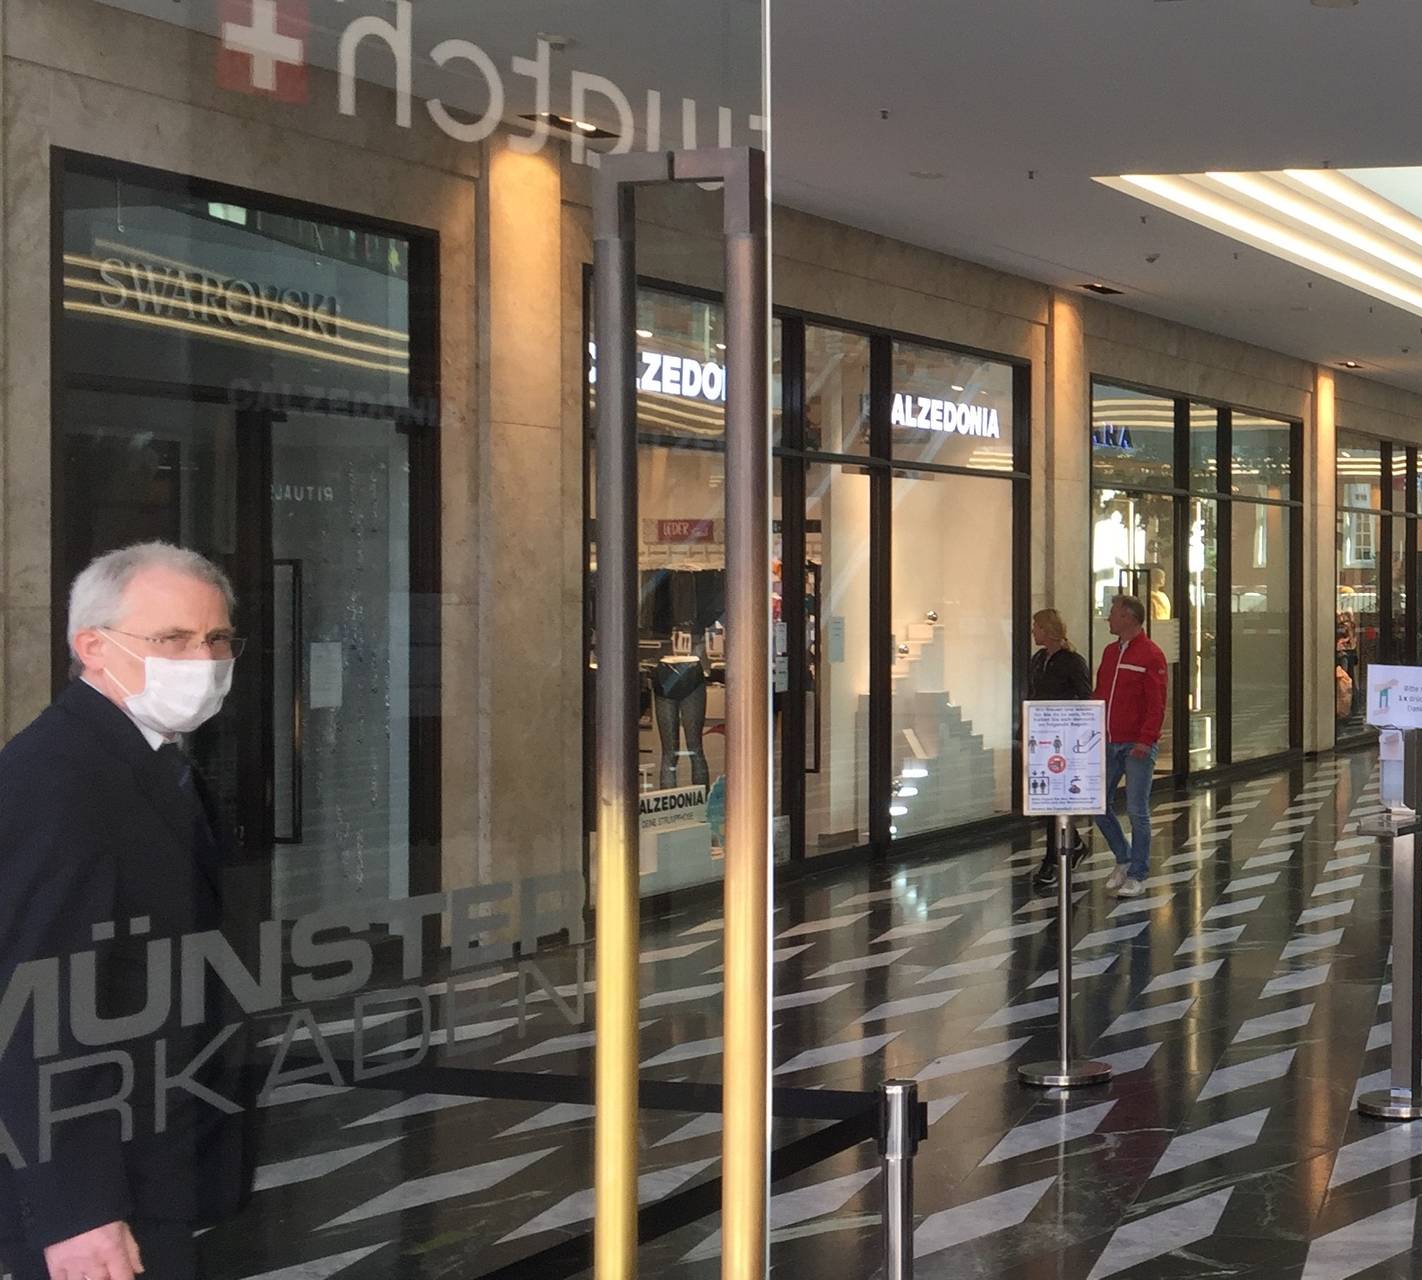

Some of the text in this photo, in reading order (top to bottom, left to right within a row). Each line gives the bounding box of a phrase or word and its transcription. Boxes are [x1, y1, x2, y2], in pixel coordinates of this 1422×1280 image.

[100, 257, 342, 341] SWAROVSKI
[891, 393, 1000, 439] ALZEDONIA
[639, 790, 704, 815] ALZEDONIA
